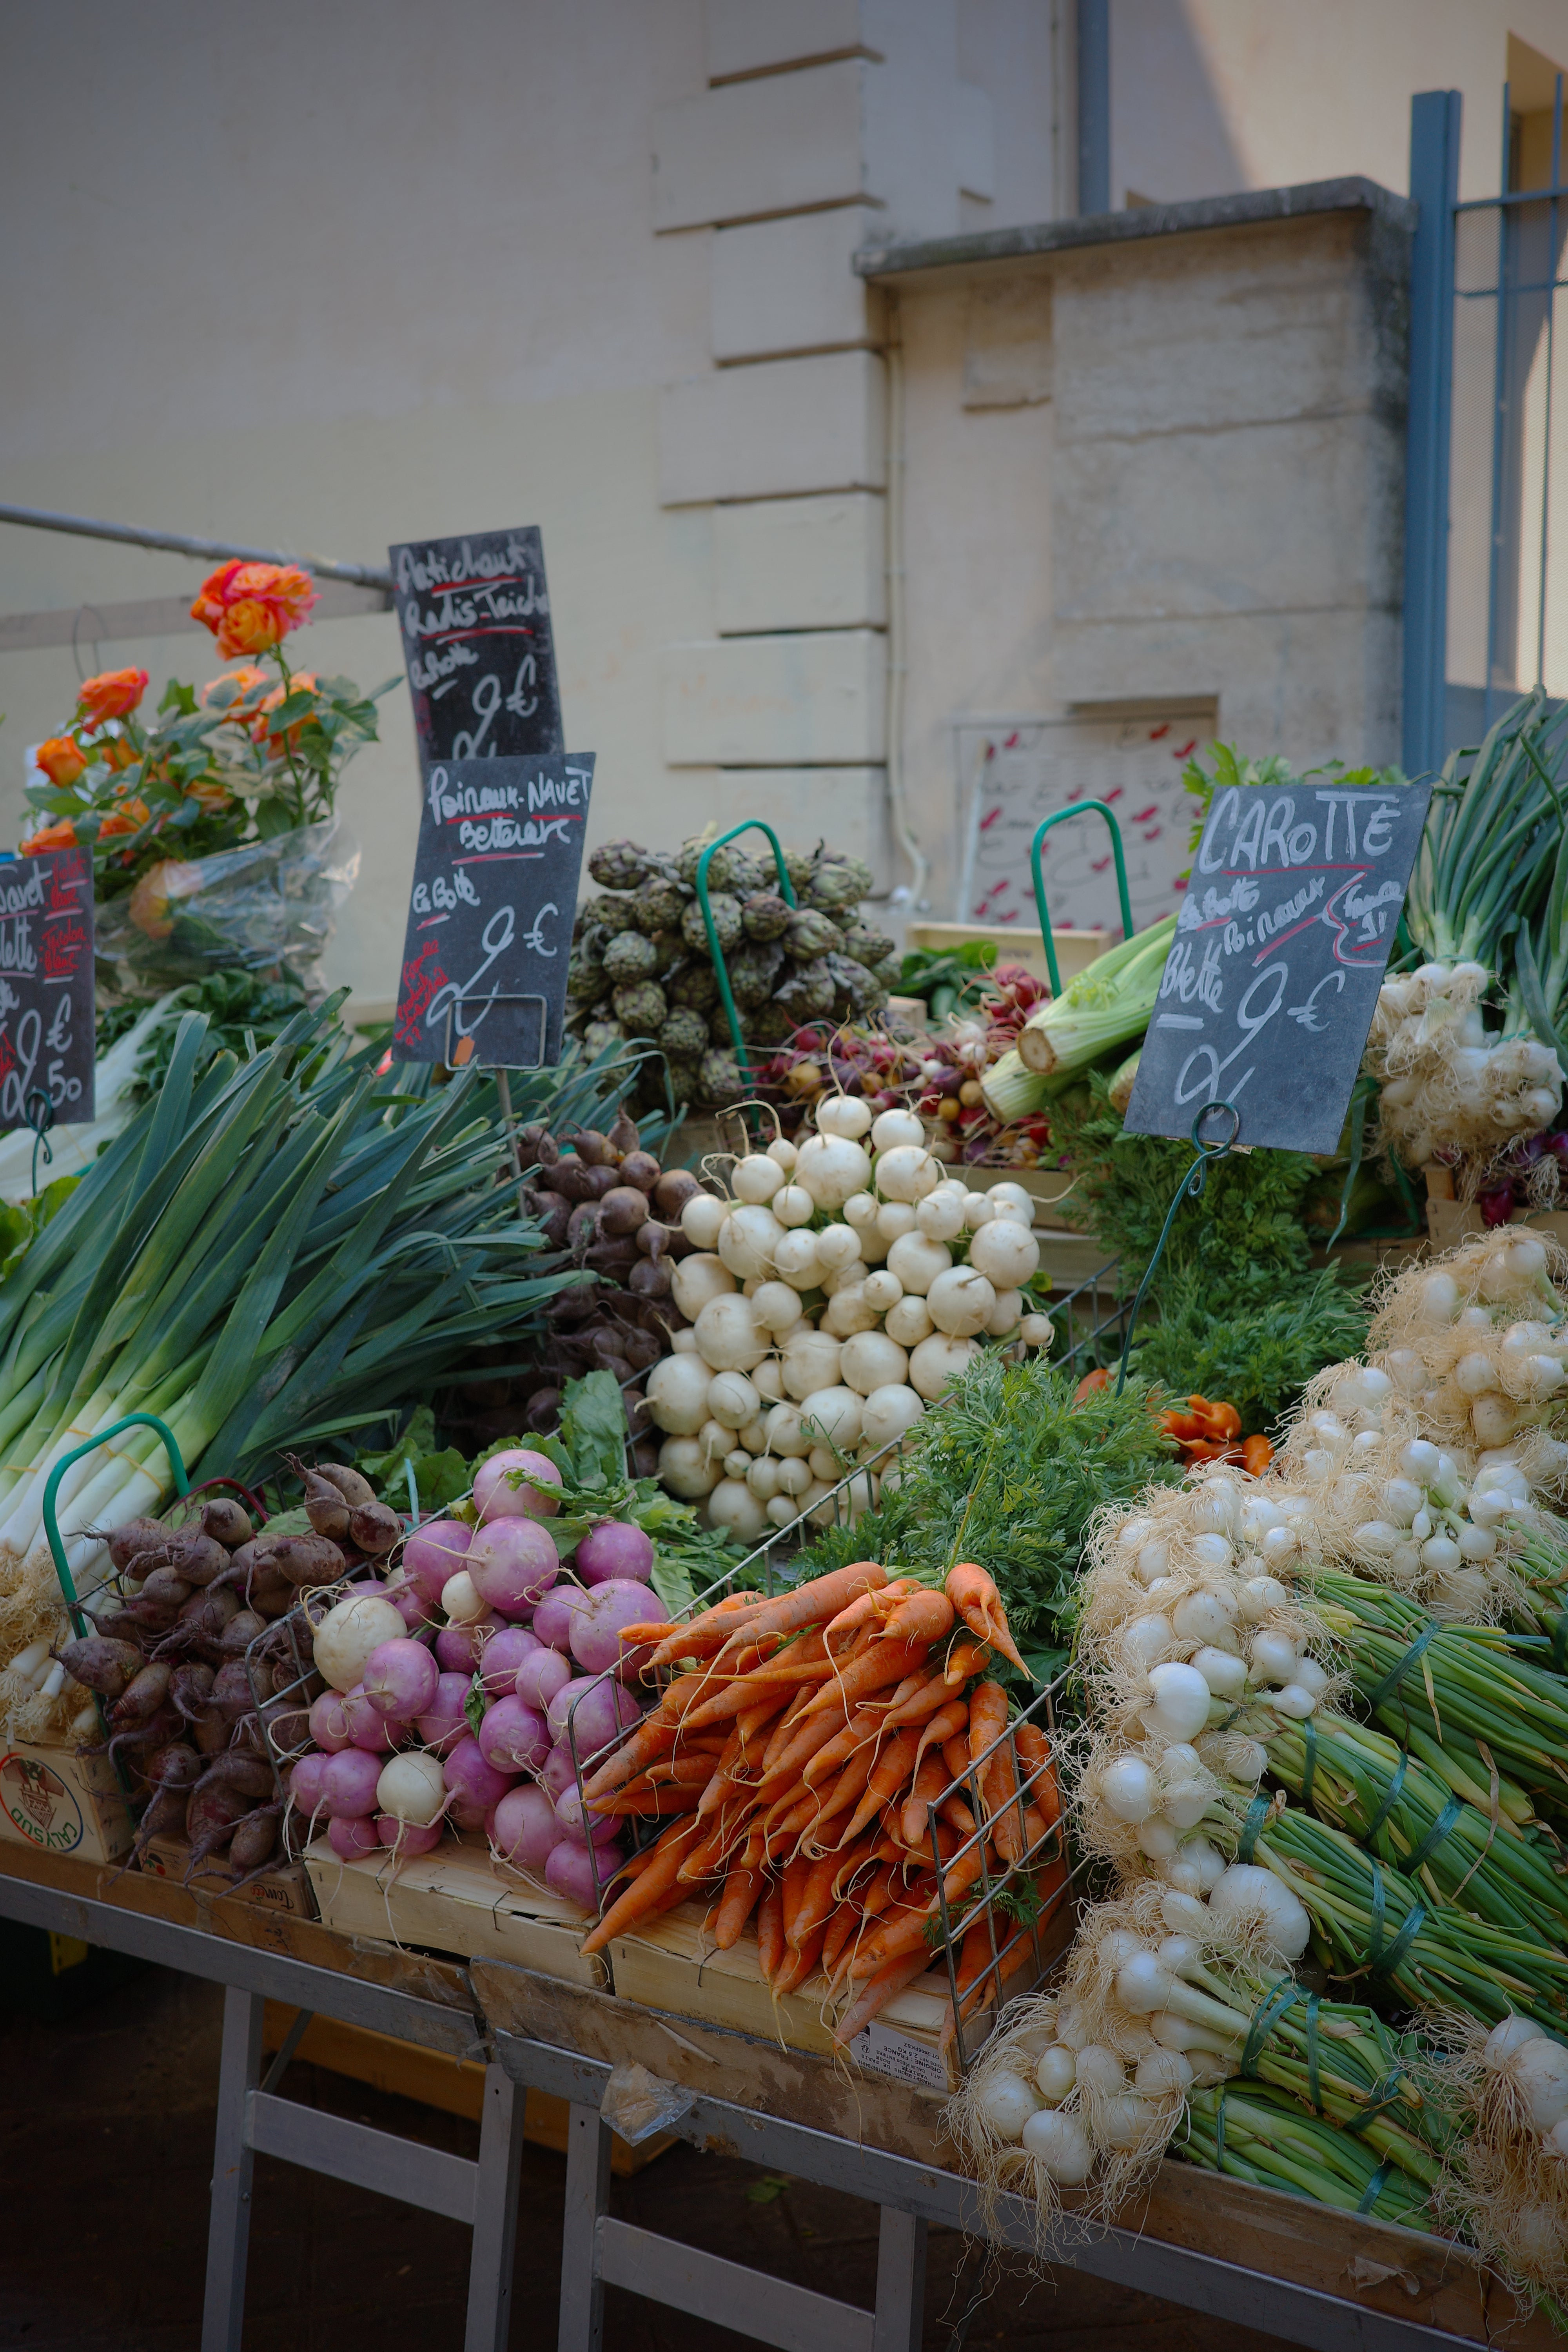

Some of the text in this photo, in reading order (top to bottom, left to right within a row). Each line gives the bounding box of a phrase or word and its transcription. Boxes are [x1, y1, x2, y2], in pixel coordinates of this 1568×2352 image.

[528, 766, 593, 813] NAVET
[1198, 786, 1401, 875] CAROTTE
[11, 1807, 78, 1848] CALYSUD
[861, 2054, 880, 2064] PARIS
[875, 2055, 891, 2065] ROSE
[876, 2050, 896, 2061] ENTIERS
[883, 2045, 942, 2074] ORIGINE FRANCE
[894, 2068, 935, 2087] CHAMPIGNONS
[902, 2066, 928, 2080] VARIETE
